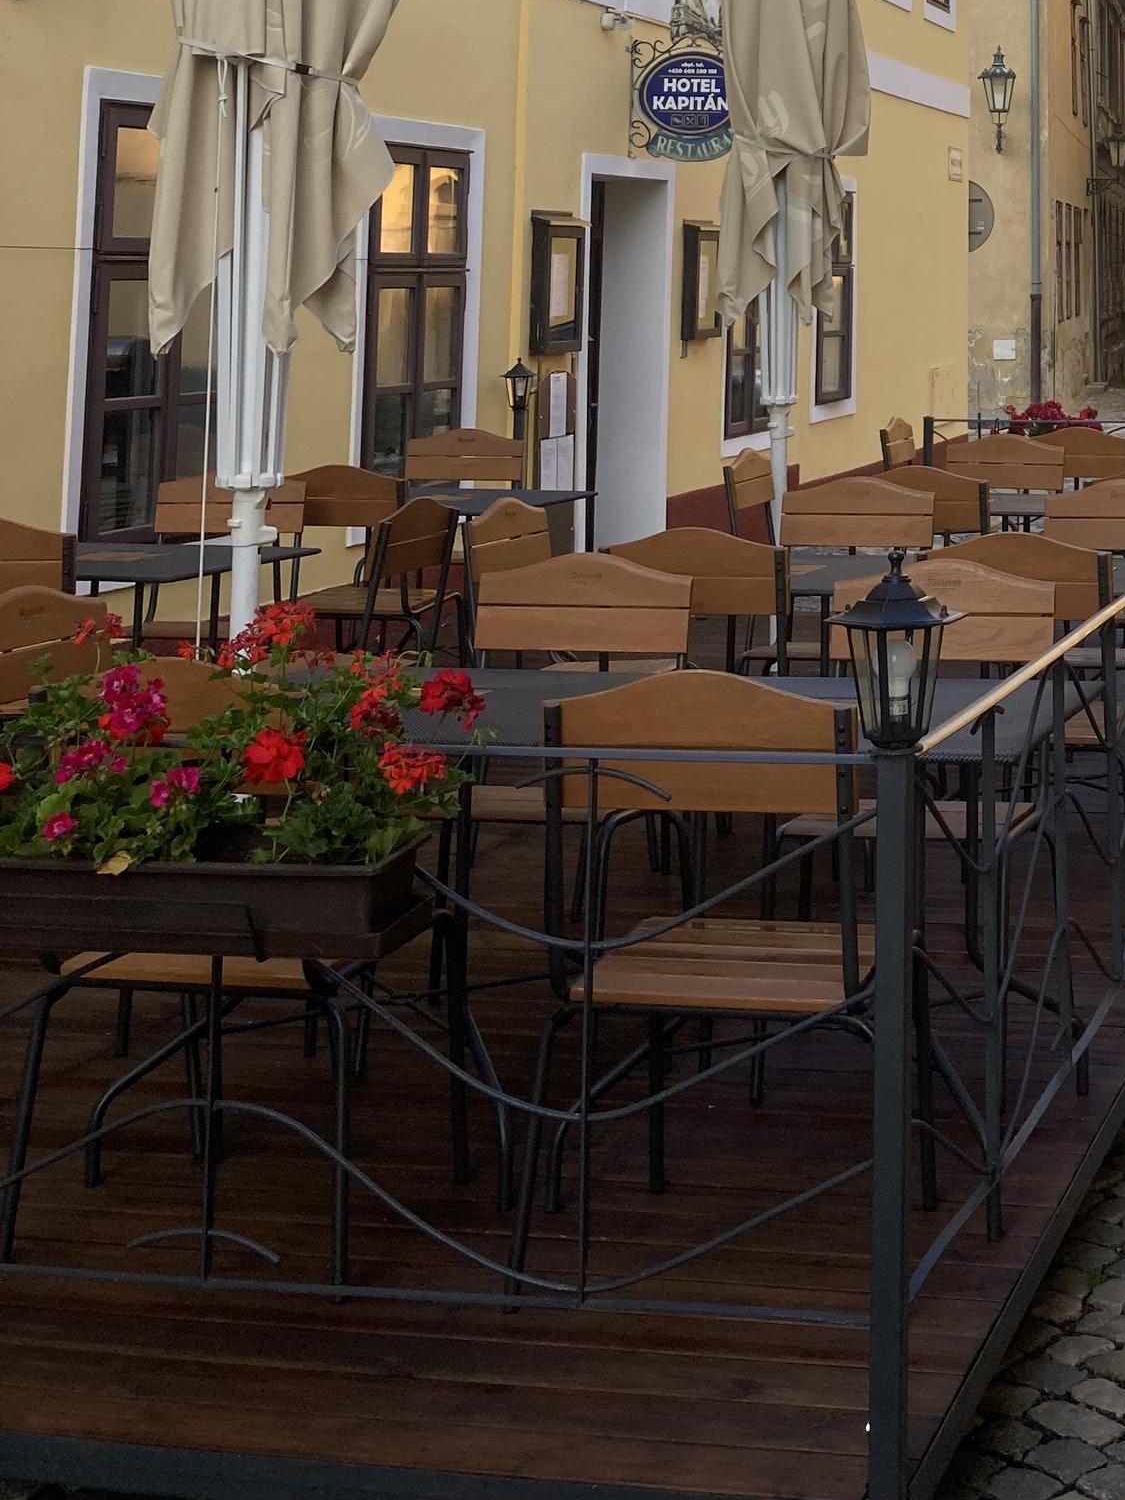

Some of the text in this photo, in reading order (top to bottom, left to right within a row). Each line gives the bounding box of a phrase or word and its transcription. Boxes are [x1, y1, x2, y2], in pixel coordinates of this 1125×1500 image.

[663, 78, 721, 92] HOTEL
[653, 93, 729, 110] KAPITÁN
[656, 133, 732, 158] RESTAURA
